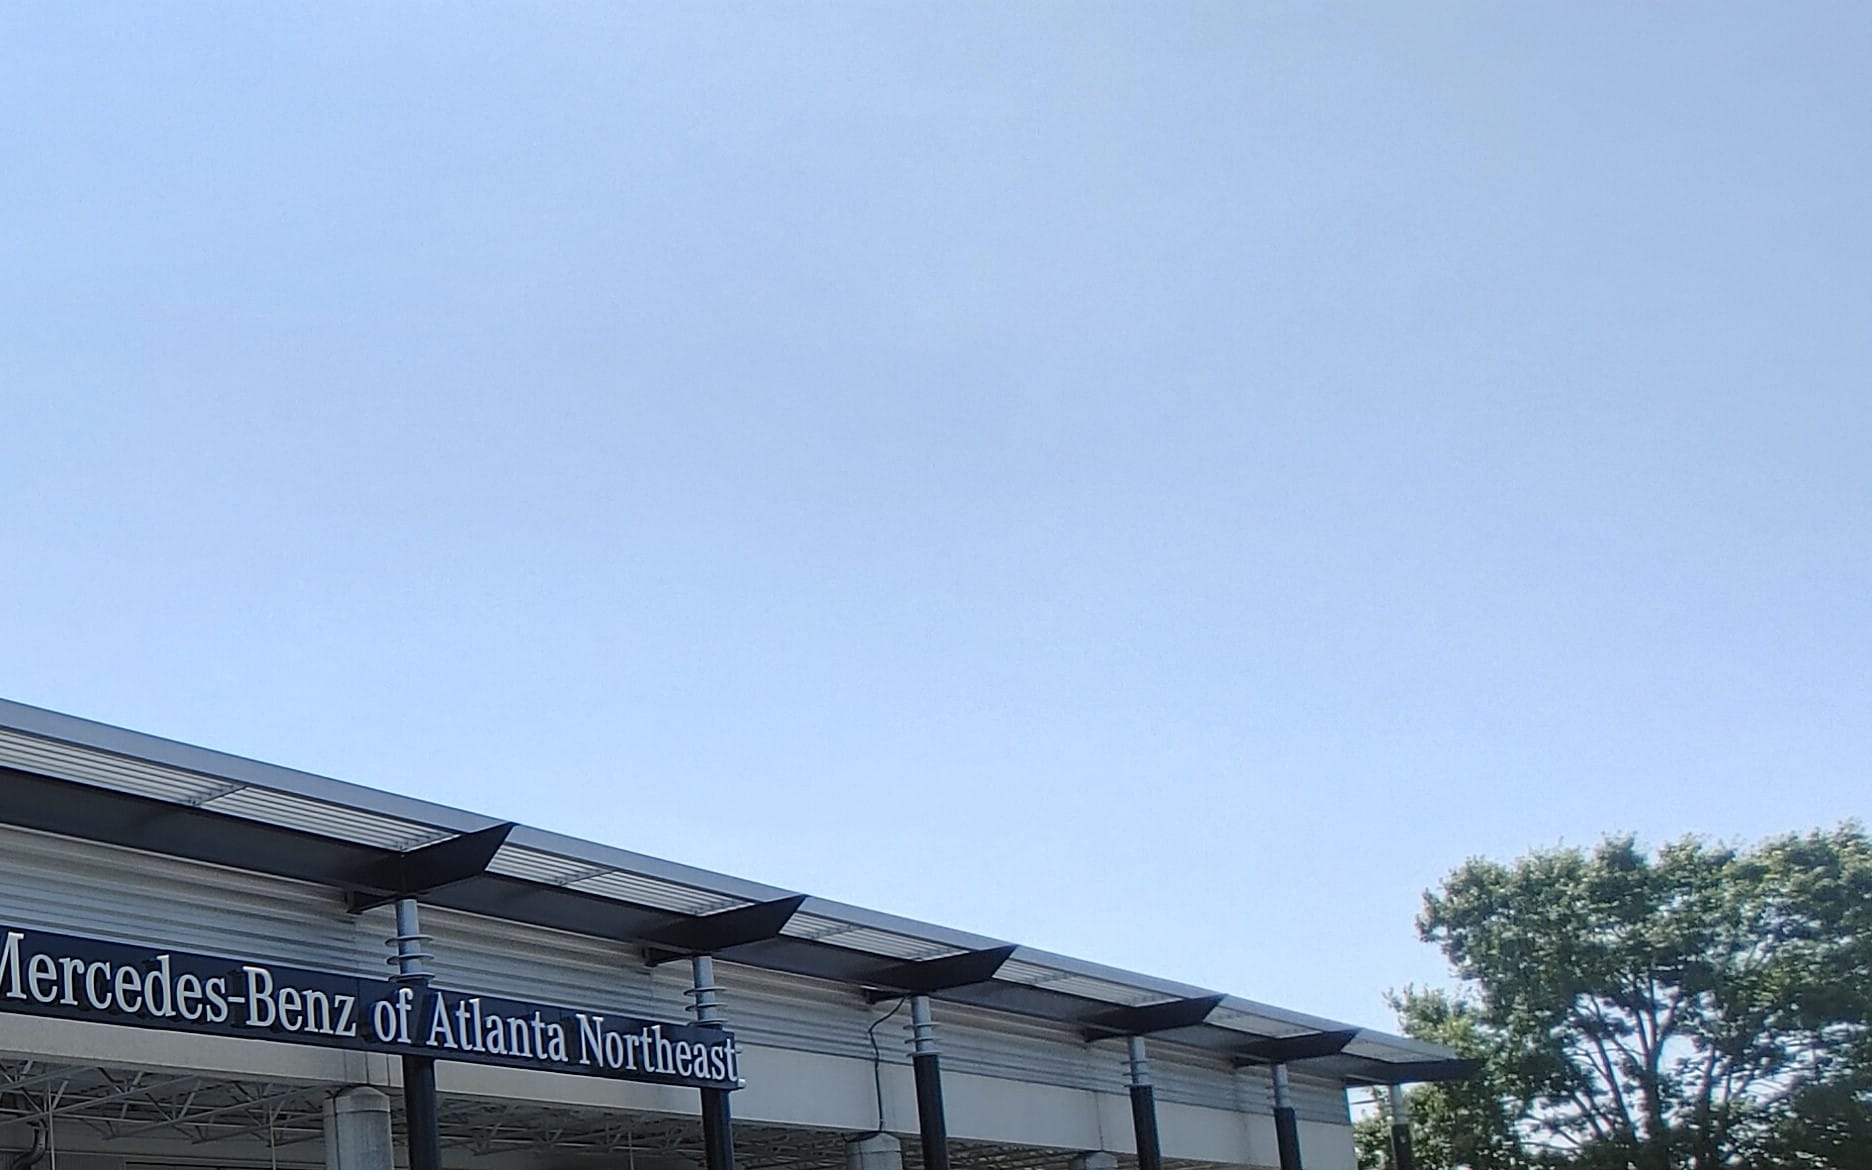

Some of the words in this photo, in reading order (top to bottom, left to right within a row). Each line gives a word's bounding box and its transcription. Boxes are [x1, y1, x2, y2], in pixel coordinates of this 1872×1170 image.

[373, 987, 414, 1044] of
[427, 992, 568, 1063] Atlanta
[576, 1012, 739, 1083] Northeast
